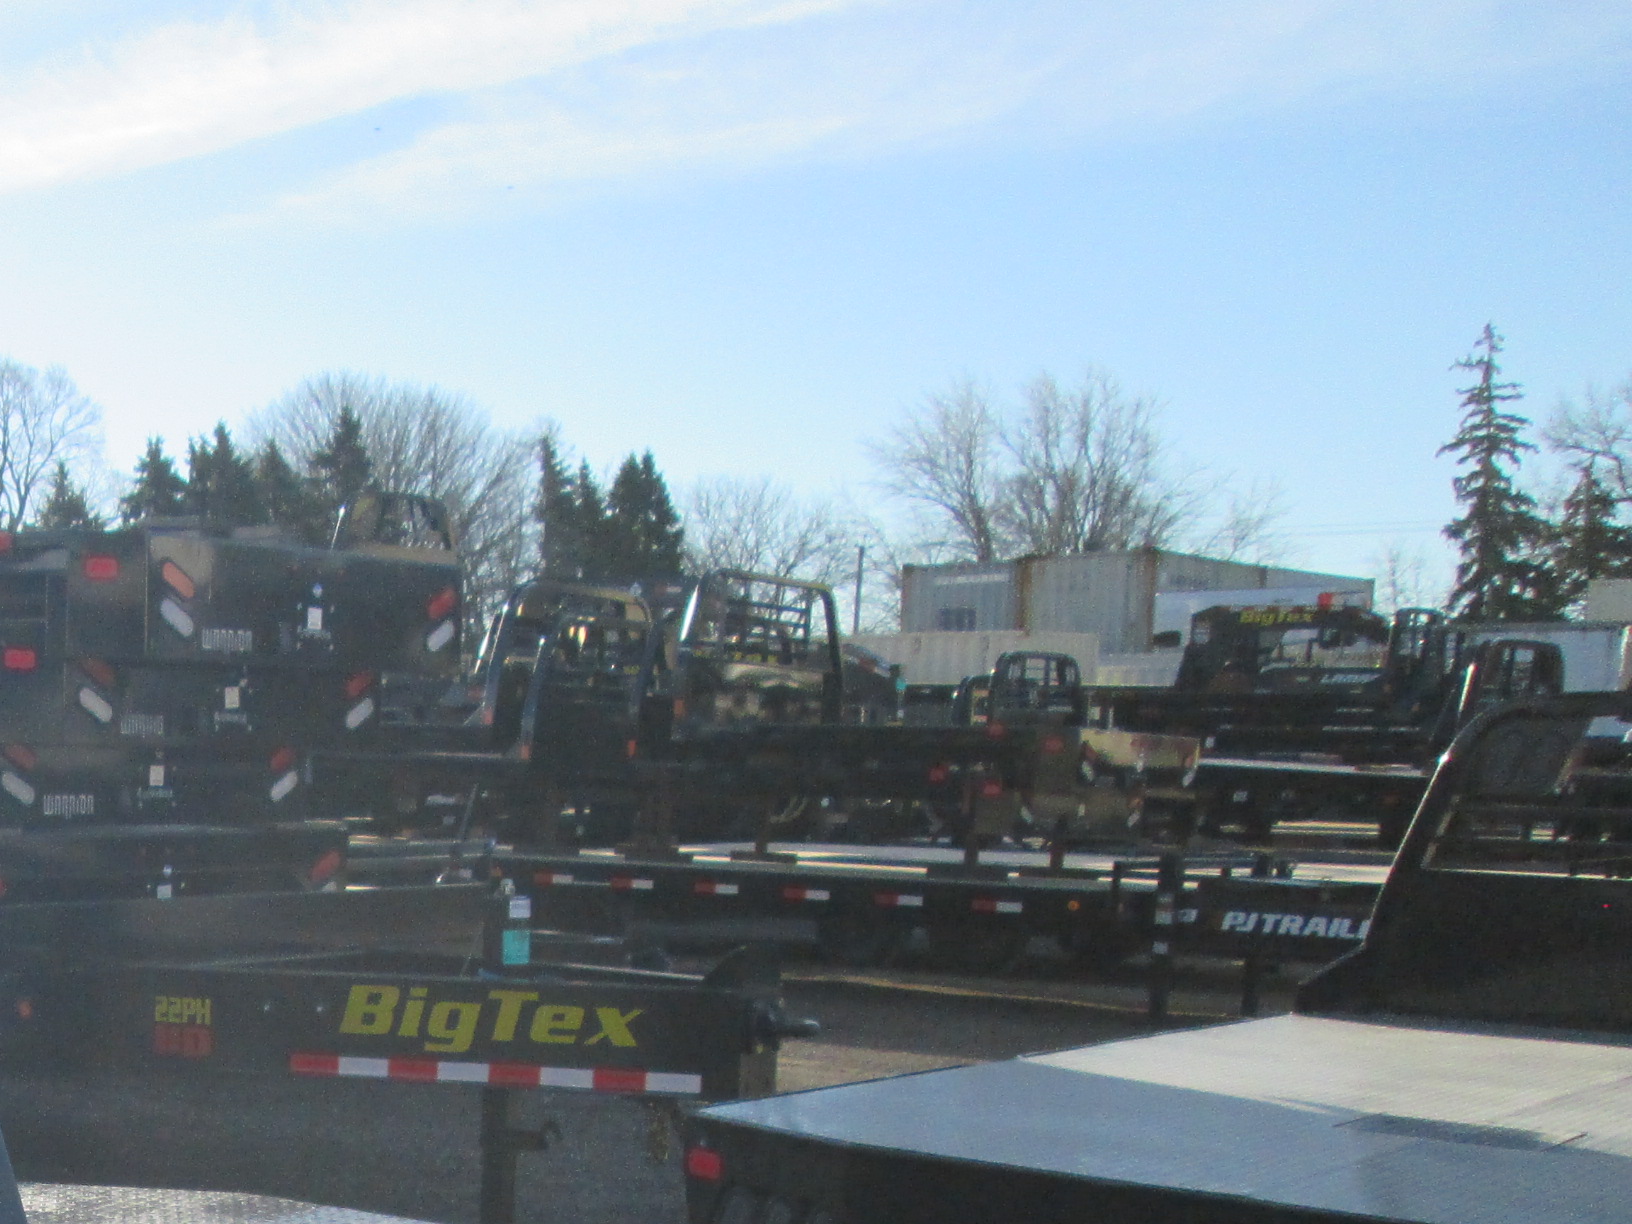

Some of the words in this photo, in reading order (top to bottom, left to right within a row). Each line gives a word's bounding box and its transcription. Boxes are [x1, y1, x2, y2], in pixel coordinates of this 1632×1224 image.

[1220, 910, 1258, 932] PJ
[154, 996, 212, 1025] 22PH
[339, 984, 645, 1052] BigTex
